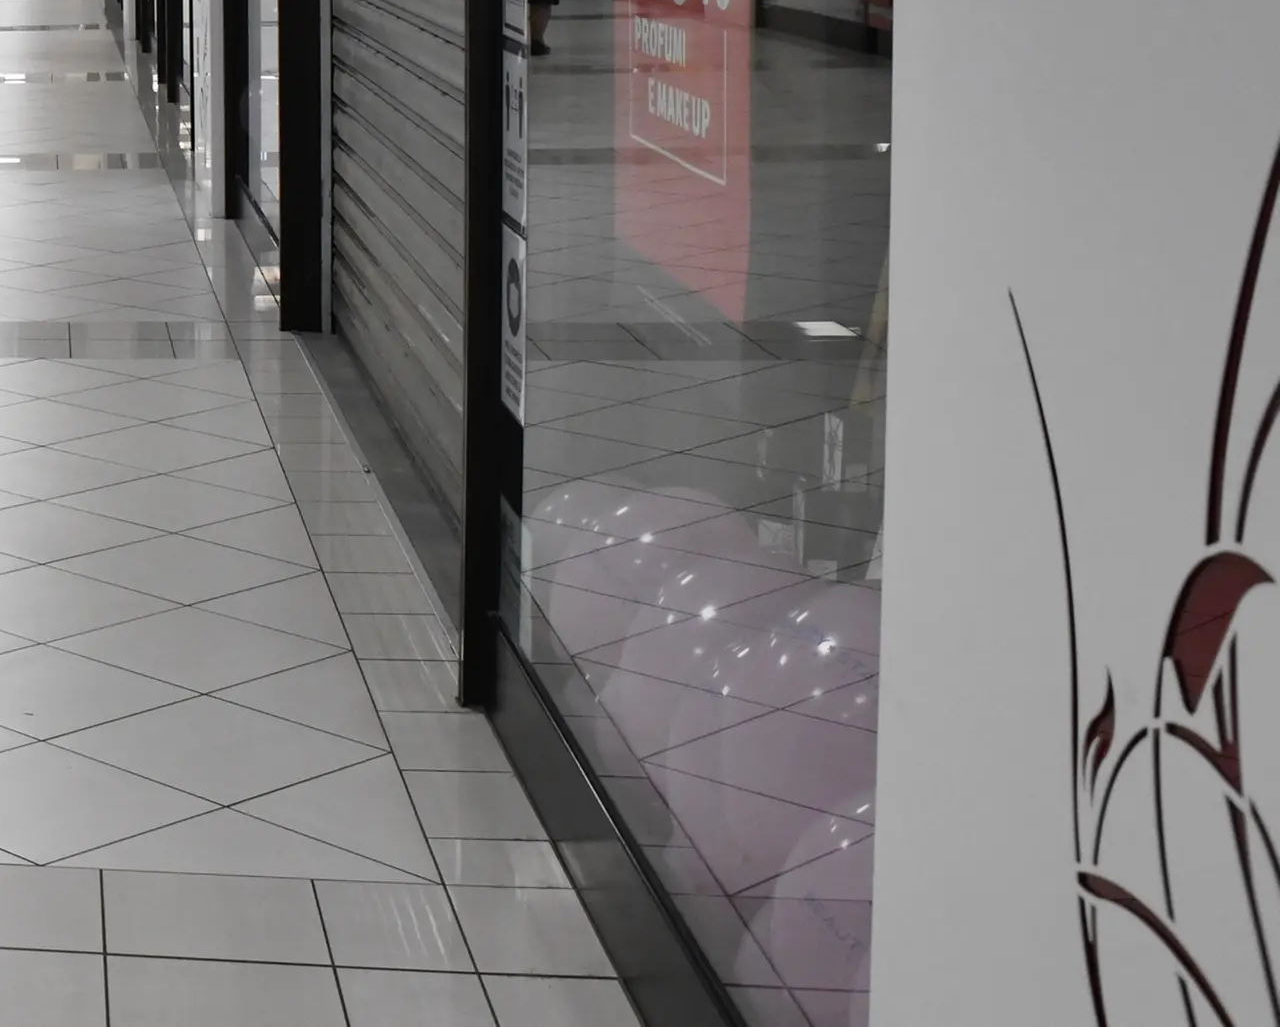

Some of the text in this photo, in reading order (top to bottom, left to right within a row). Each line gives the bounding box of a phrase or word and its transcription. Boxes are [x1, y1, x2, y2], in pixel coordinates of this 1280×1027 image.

[633, 15, 687, 68] PROFUMI
[648, 78, 711, 139] E MAKE UP
